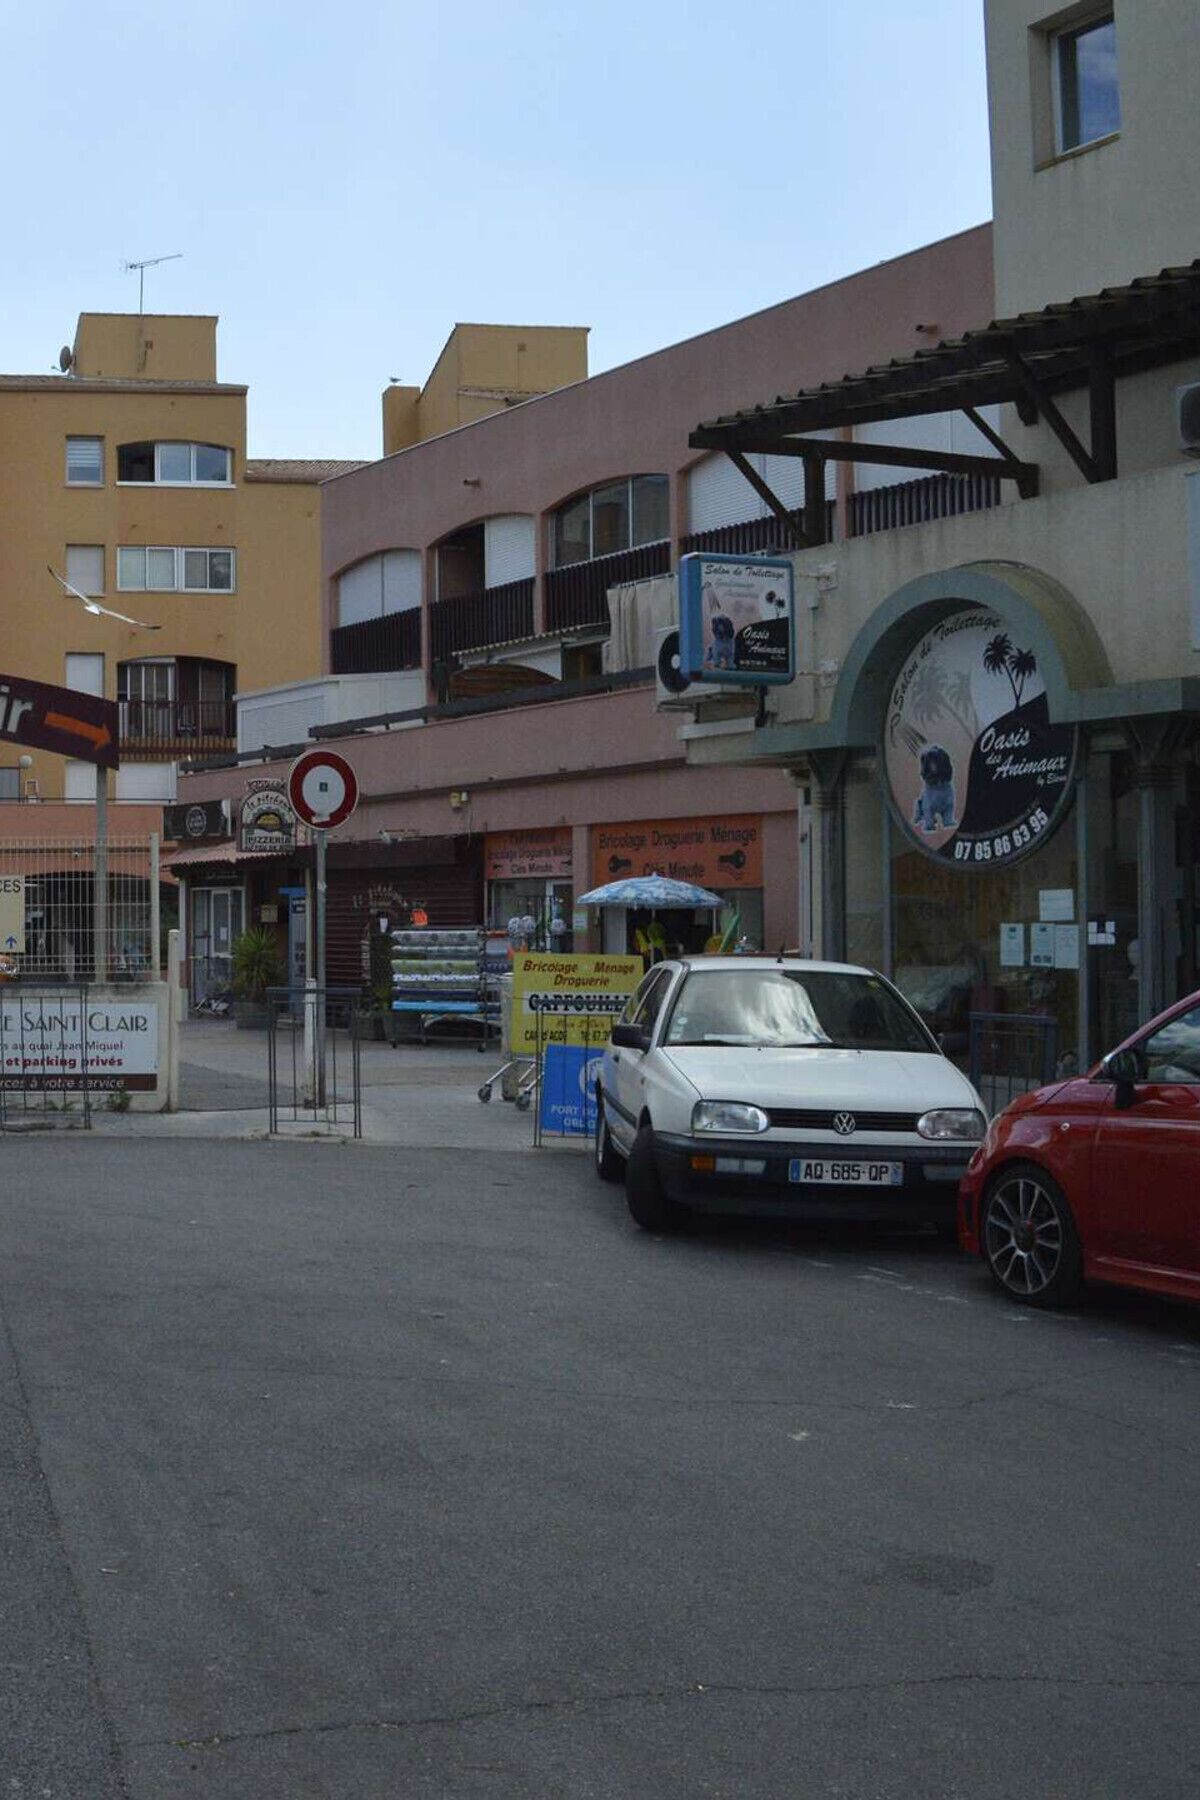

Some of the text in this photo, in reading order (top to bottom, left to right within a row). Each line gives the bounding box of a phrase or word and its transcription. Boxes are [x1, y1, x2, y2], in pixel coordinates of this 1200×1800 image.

[742, 626, 770, 641] Oasis
[980, 727, 1030, 753] Oasis
[985, 752, 1002, 765] des
[992, 755, 1067, 781] Animaux
[599, 825, 757, 852] Bricolage Droguerie Ménage
[953, 808, 1049, 862] 07 85 86 63 95
[668, 861, 706, 879] Minute
[523, 958, 578, 974] Bricolage
[554, 974, 610, 989] Droguerie
[23, 1011, 80, 1032] SAINT
[88, 1011, 148, 1032] CLAIR
[11, 1042, 25, 1050] au
[29, 1041, 52, 1053] quai
[56, 1041, 81, 1051] Jean
[85, 1041, 124, 1053] Miquel
[6, 1057, 20, 1067] et
[22, 1056, 76, 1069] parking
[551, 1103, 578, 1115] PORT
[803, 1162, 889, 1182] AQ-685-QP
